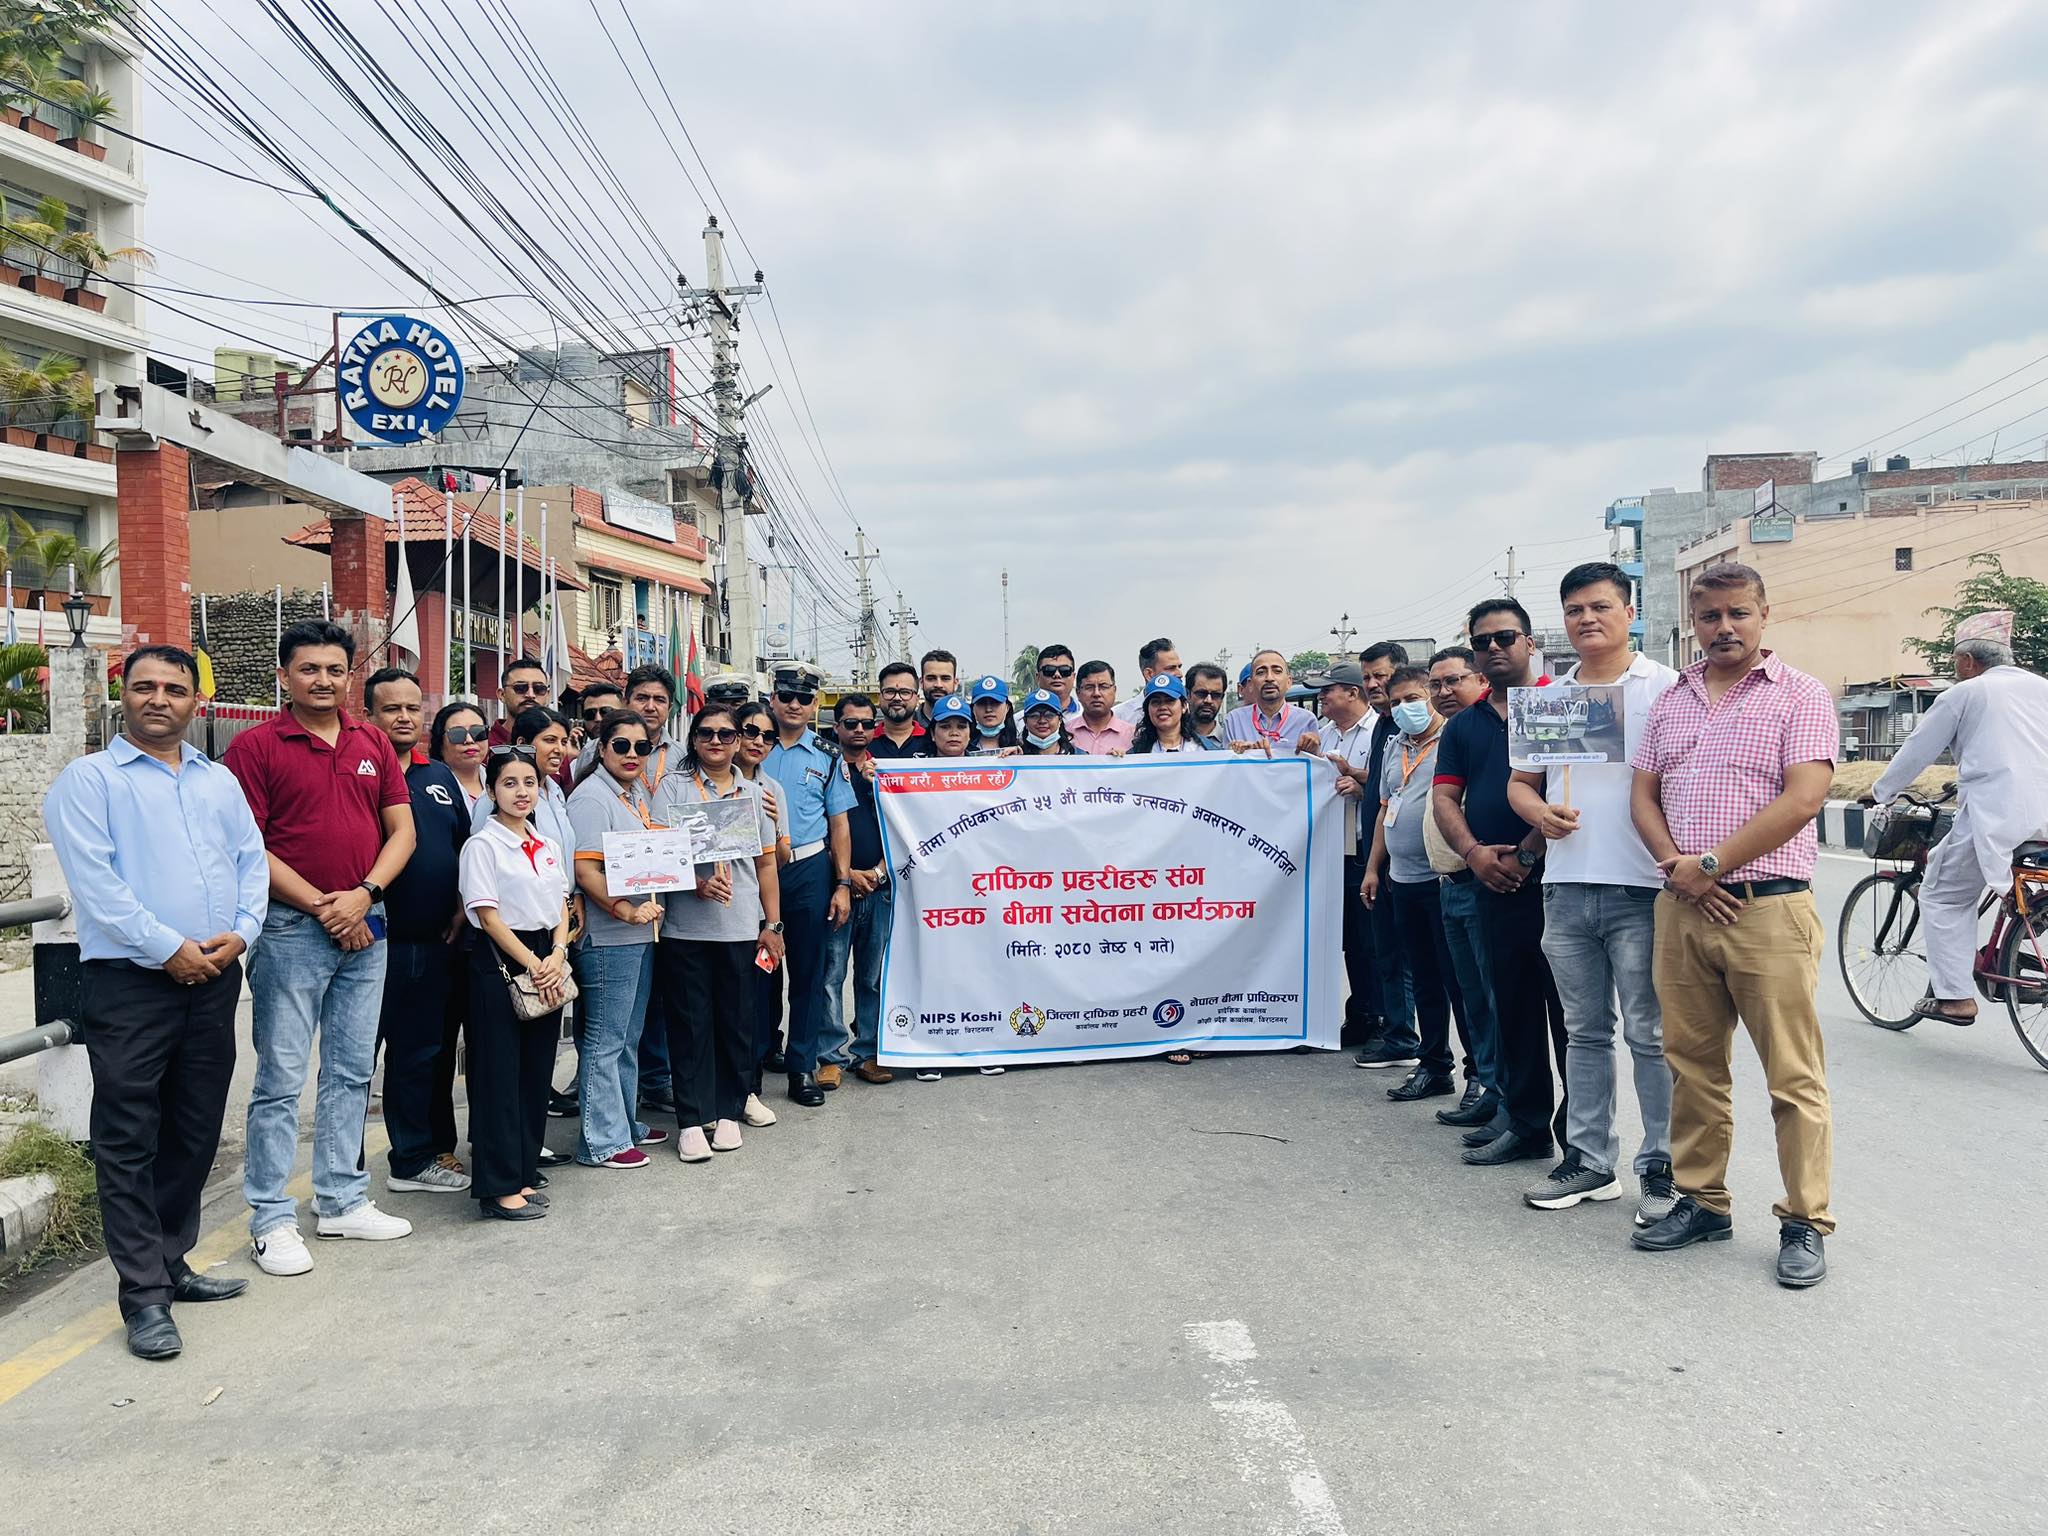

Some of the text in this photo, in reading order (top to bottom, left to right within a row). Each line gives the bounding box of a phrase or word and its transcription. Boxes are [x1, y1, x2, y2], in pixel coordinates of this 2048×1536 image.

[341, 321, 456, 410] RATNA HOTEL
[941, 772, 981, 788] सुरक्षित
[916, 832, 946, 858] बीमा
[947, 797, 1027, 839] प्राधिकरणको
[1083, 787, 1126, 804] वार्षिक
[1132, 793, 1188, 814] उत्सवको
[1192, 806, 1246, 838] अवसरमा
[1248, 834, 1297, 876] आयोजित
[972, 866, 1054, 896] ट्राफिक
[1165, 865, 1205, 887] संग
[922, 897, 1256, 928] सडक बीमा सचेतना कार्यक्रम
[1055, 943, 1091, 958] २०८०
[1099, 939, 1127, 954] जेष्ठ
[1190, 991, 1299, 1007] नेपाल बीमा प्राधिकरण
[920, 1011, 1002, 1024] NIPS Koshi
[1046, 1006, 1148, 1020] जिल्ला ट्राफिक प्रहरी
